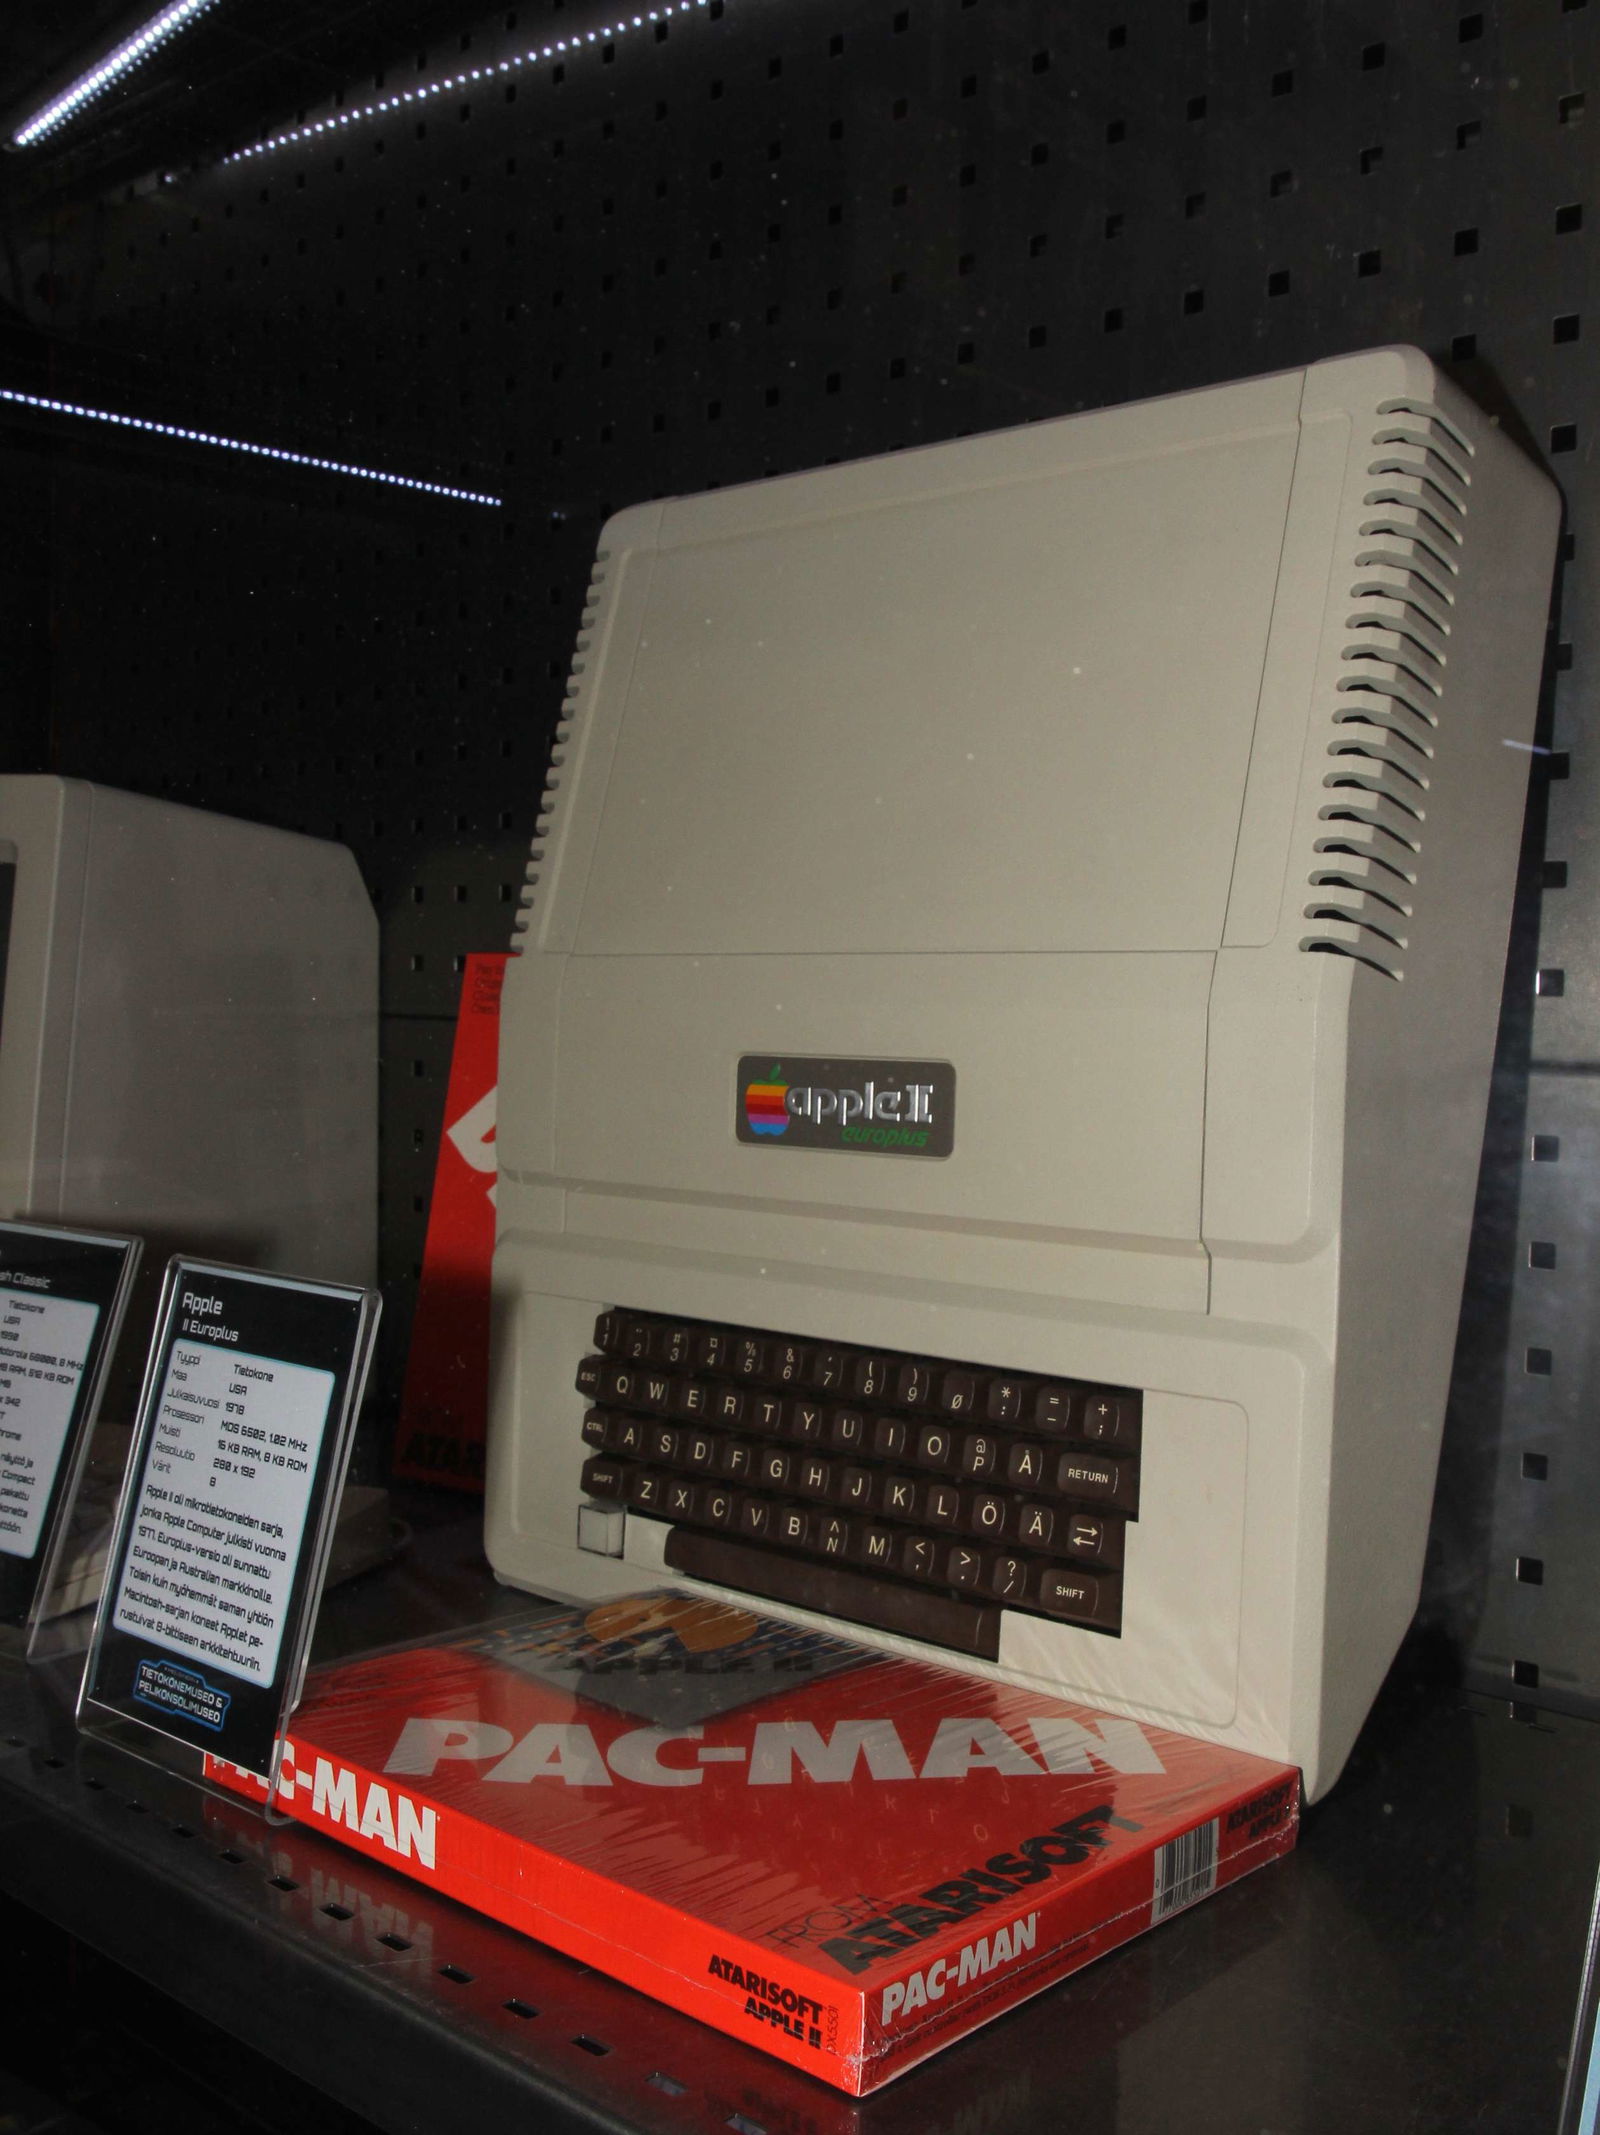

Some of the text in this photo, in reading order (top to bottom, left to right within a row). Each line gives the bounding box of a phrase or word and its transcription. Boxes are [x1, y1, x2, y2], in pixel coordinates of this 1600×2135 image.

[786, 1081, 901, 1127] apple
[841, 1126, 931, 1148] europlus
[12, 1271, 51, 1289] Classic
[182, 1291, 224, 1317] Apple
[182, 1318, 240, 1342] II Europlus
[177, 1350, 275, 1383] Tyyppi Tietokone
[56, 1375, 75, 1386] ROM
[171, 1368, 248, 1397] Maa USA
[616, 1375, 628, 1395] Q
[649, 1381, 665, 1400] W
[167, 1388, 246, 1416] Julkaisuvuosi 1978
[687, 1389, 699, 1408] E
[723, 1396, 736, 1415] R
[763, 1404, 774, 1423] T
[803, 1411, 815, 1431] Y
[221, 1420, 240, 1434] MOS
[241, 1426, 267, 1443] 6502,
[288, 1438, 308, 1453] MHz
[586, 1421, 605, 1433] CTRL
[623, 1427, 635, 1445] A
[842, 1419, 855, 1439] U
[660, 1434, 671, 1453] S
[693, 1442, 706, 1460] D
[926, 1435, 942, 1456] O
[218, 1439, 227, 1450] 16
[227, 1442, 240, 1455] KB
[241, 1446, 262, 1463] RAM,
[264, 1452, 272, 1463] 8
[272, 1454, 286, 1468] KB
[286, 1458, 308, 1473] ROM
[731, 1450, 743, 1469] F
[973, 1456, 985, 1471] P
[1018, 1449, 1032, 1475] Å
[2, 1470, 36, 1485] Compact
[213, 1458, 232, 1472] 280
[232, 1465, 239, 1475] x
[240, 1466, 257, 1480] 192
[592, 1473, 614, 1484] SHIFT
[770, 1459, 782, 1478] G
[808, 1467, 823, 1487] H
[1067, 1468, 1109, 1484] RETURN
[209, 1477, 217, 1487] 8
[640, 1481, 653, 1500] Z
[851, 1477, 863, 1497] J
[675, 1489, 687, 1509] X
[892, 1485, 906, 1507] K
[936, 1494, 948, 1516] L
[146, 1484, 284, 1539] Apple II oli mikrotietokoneiden sarja,
[712, 1498, 724, 1517] C
[751, 1507, 763, 1527] V
[981, 1501, 997, 1525] Ö
[140, 1503, 287, 1562] jonka Apple Computer julkisti vuonna
[787, 1515, 801, 1535] B
[1028, 1511, 1043, 1536] Ä
[157, 1531, 221, 1563] Europlus-versio
[222, 1553, 233, 1567] oli
[826, 1536, 839, 1553] N
[868, 1535, 885, 1556] M
[133, 1545, 272, 1604] Euroopan ja Australian markkinoille.
[129, 1566, 274, 1628] Toisin kuin myöhemmät saman yhtiön
[1055, 1585, 1085, 1600] SHIFT
[120, 1607, 156, 1630] rustuivat
[155, 1620, 200, 1647] 8-bittiseen
[124, 1586, 264, 1648] Macintosh-sarjan koneet Applet pe-
[141, 1665, 215, 1706] TIETOKONEMUSEO
[214, 1696, 224, 1709] &
[138, 1679, 221, 1724] PELIKONSOLIMUSEO
[382, 1716, 1168, 1787] PAC-MAN
[212, 1738, 437, 1871] C-MAN
[818, 1803, 1146, 1976] ATARISOFT
[764, 1892, 893, 1949] FROM
[881, 1911, 1038, 2027] PAC-MAN
[708, 1953, 824, 2025] ATARISOFT
[744, 1996, 823, 2050] APPLE II
